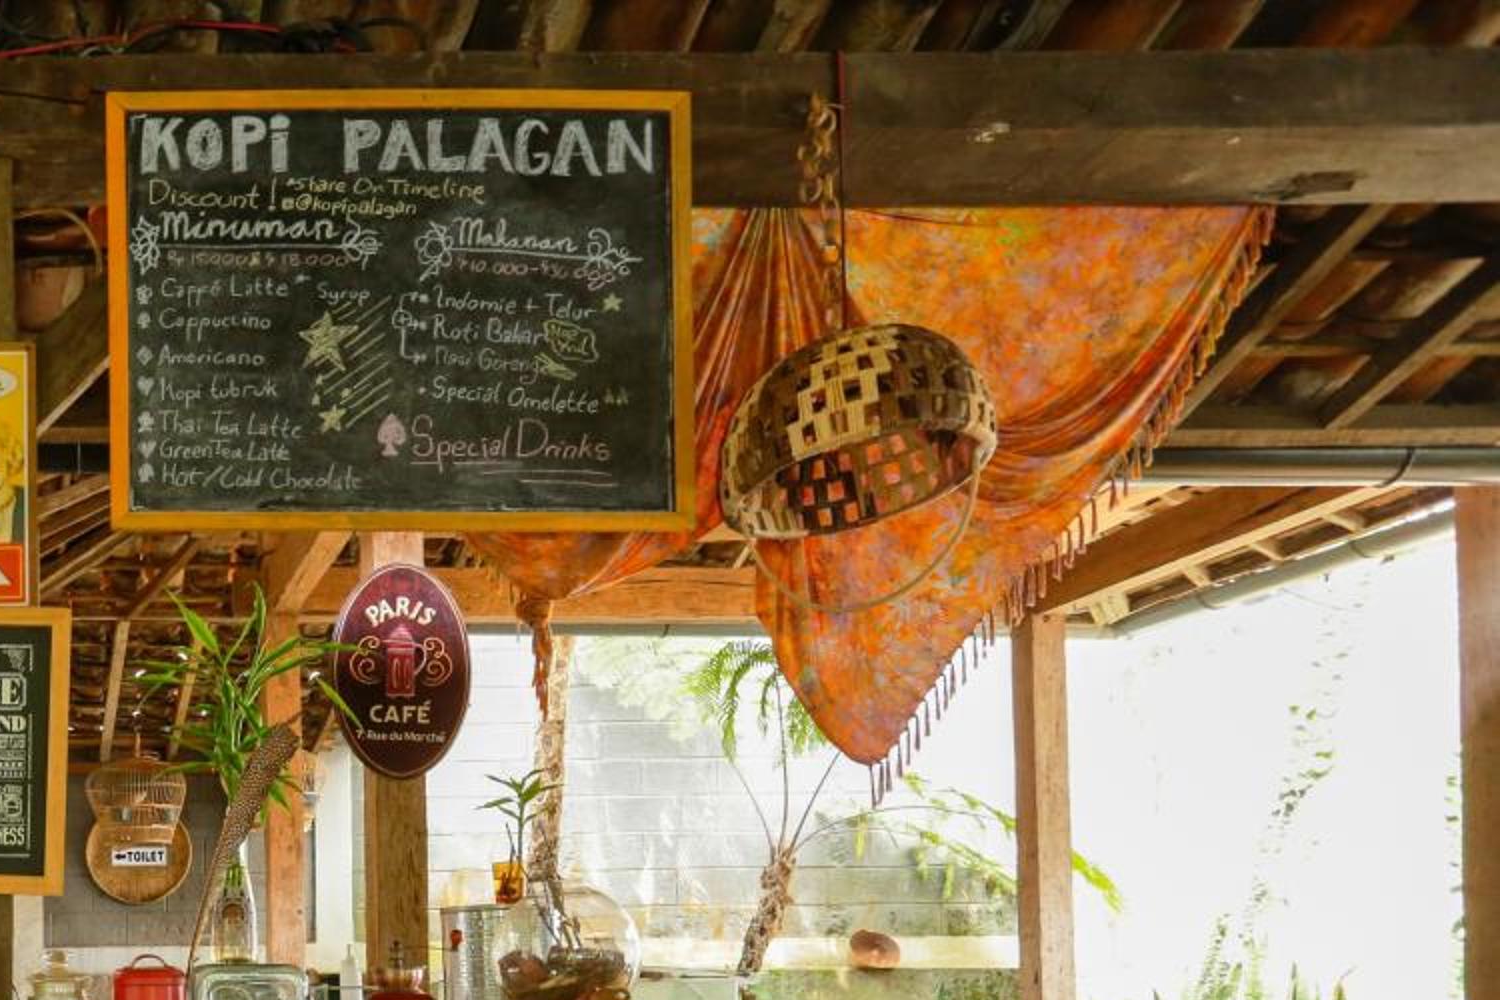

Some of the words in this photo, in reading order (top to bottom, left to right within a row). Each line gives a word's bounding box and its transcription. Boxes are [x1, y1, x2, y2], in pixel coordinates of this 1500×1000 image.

[343, 117, 654, 176] PALAGAN
[387, 178, 486, 204] Timeline
[160, 210, 340, 241] Minuman
[453, 216, 580, 253] Makanan
[317, 282, 370, 306] Syrup
[434, 287, 517, 315] Indomie
[545, 293, 597, 321] Telur
[432, 313, 479, 340] Roti
[487, 316, 548, 346] Bakar
[157, 343, 265, 367] Americano
[478, 347, 543, 385] Goreng
[432, 374, 502, 403] Special
[507, 384, 600, 415] Omelette
[158, 409, 200, 433] Thai
[211, 411, 240, 436] Tea
[247, 412, 303, 439] Latte
[411, 414, 512, 474] Special
[517, 417, 613, 462] Drinks
[269, 463, 364, 491] Chocolate
[365, 596, 438, 628] PARIS
[369, 700, 431, 724] CAFÉ
[127, 851, 164, 862] TOILET
